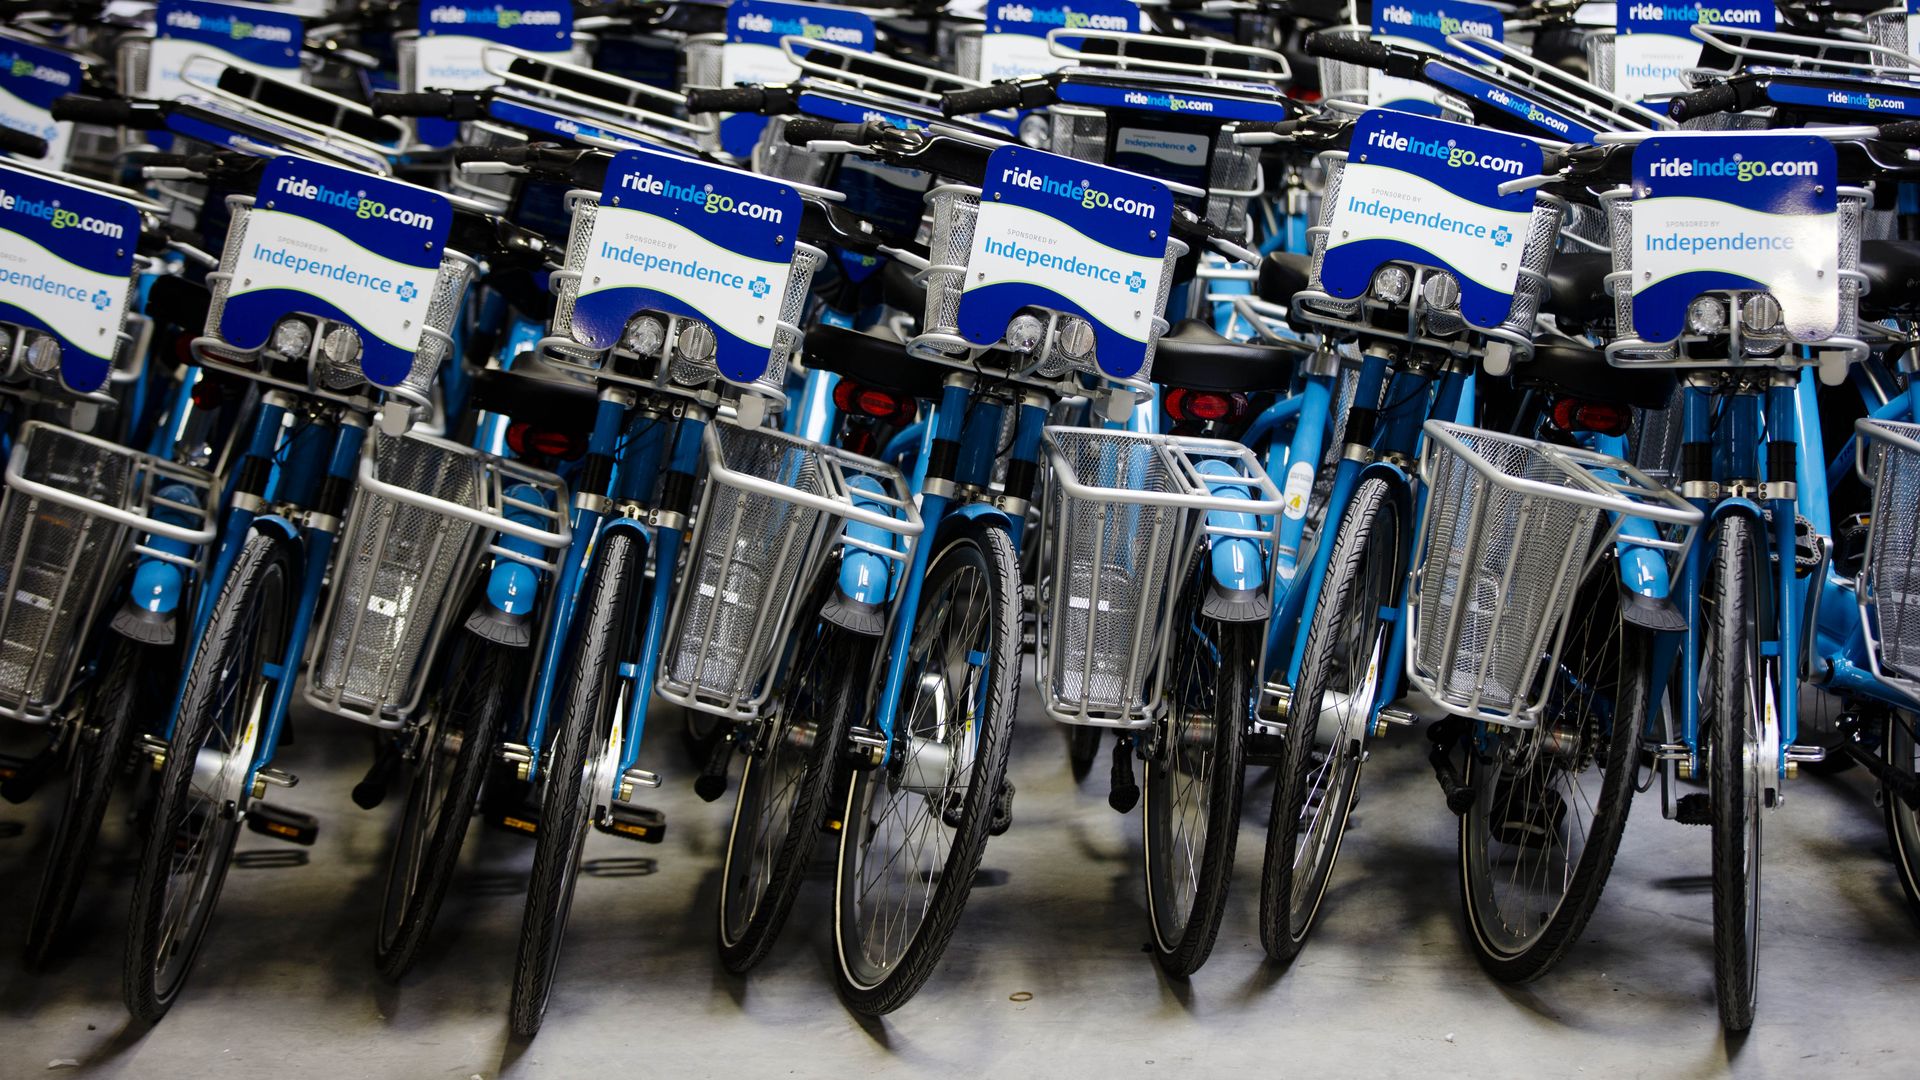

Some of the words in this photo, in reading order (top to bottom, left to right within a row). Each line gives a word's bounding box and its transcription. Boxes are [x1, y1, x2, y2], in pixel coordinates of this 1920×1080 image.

[998, 4, 1128, 30] rideIndego.com
[1383, 5, 1493, 38] rideIndego.com
[1630, 2, 1761, 25] rideIndego.com
[1625, 63, 1680, 80] Indepe
[1124, 92, 1214, 111] rideIndego.com
[1487, 89, 1569, 133] rideIndego.com
[1827, 91, 1905, 109] rideIndego.com
[1124, 138, 1186, 151] Independence
[1368, 129, 1524, 176] rideIndego.com
[1650, 156, 1819, 182] rideIndego.com
[276, 176, 434, 231] rideIndego.com
[621, 171, 783, 224] rideIndego.com
[1002, 166, 1156, 220] rideIndego.com
[1348, 196, 1487, 239] Independence
[984, 236, 1121, 284] Independence
[1646, 232, 1795, 255] Independence
[253, 243, 392, 294] Independence
[600, 241, 744, 289] Independence
